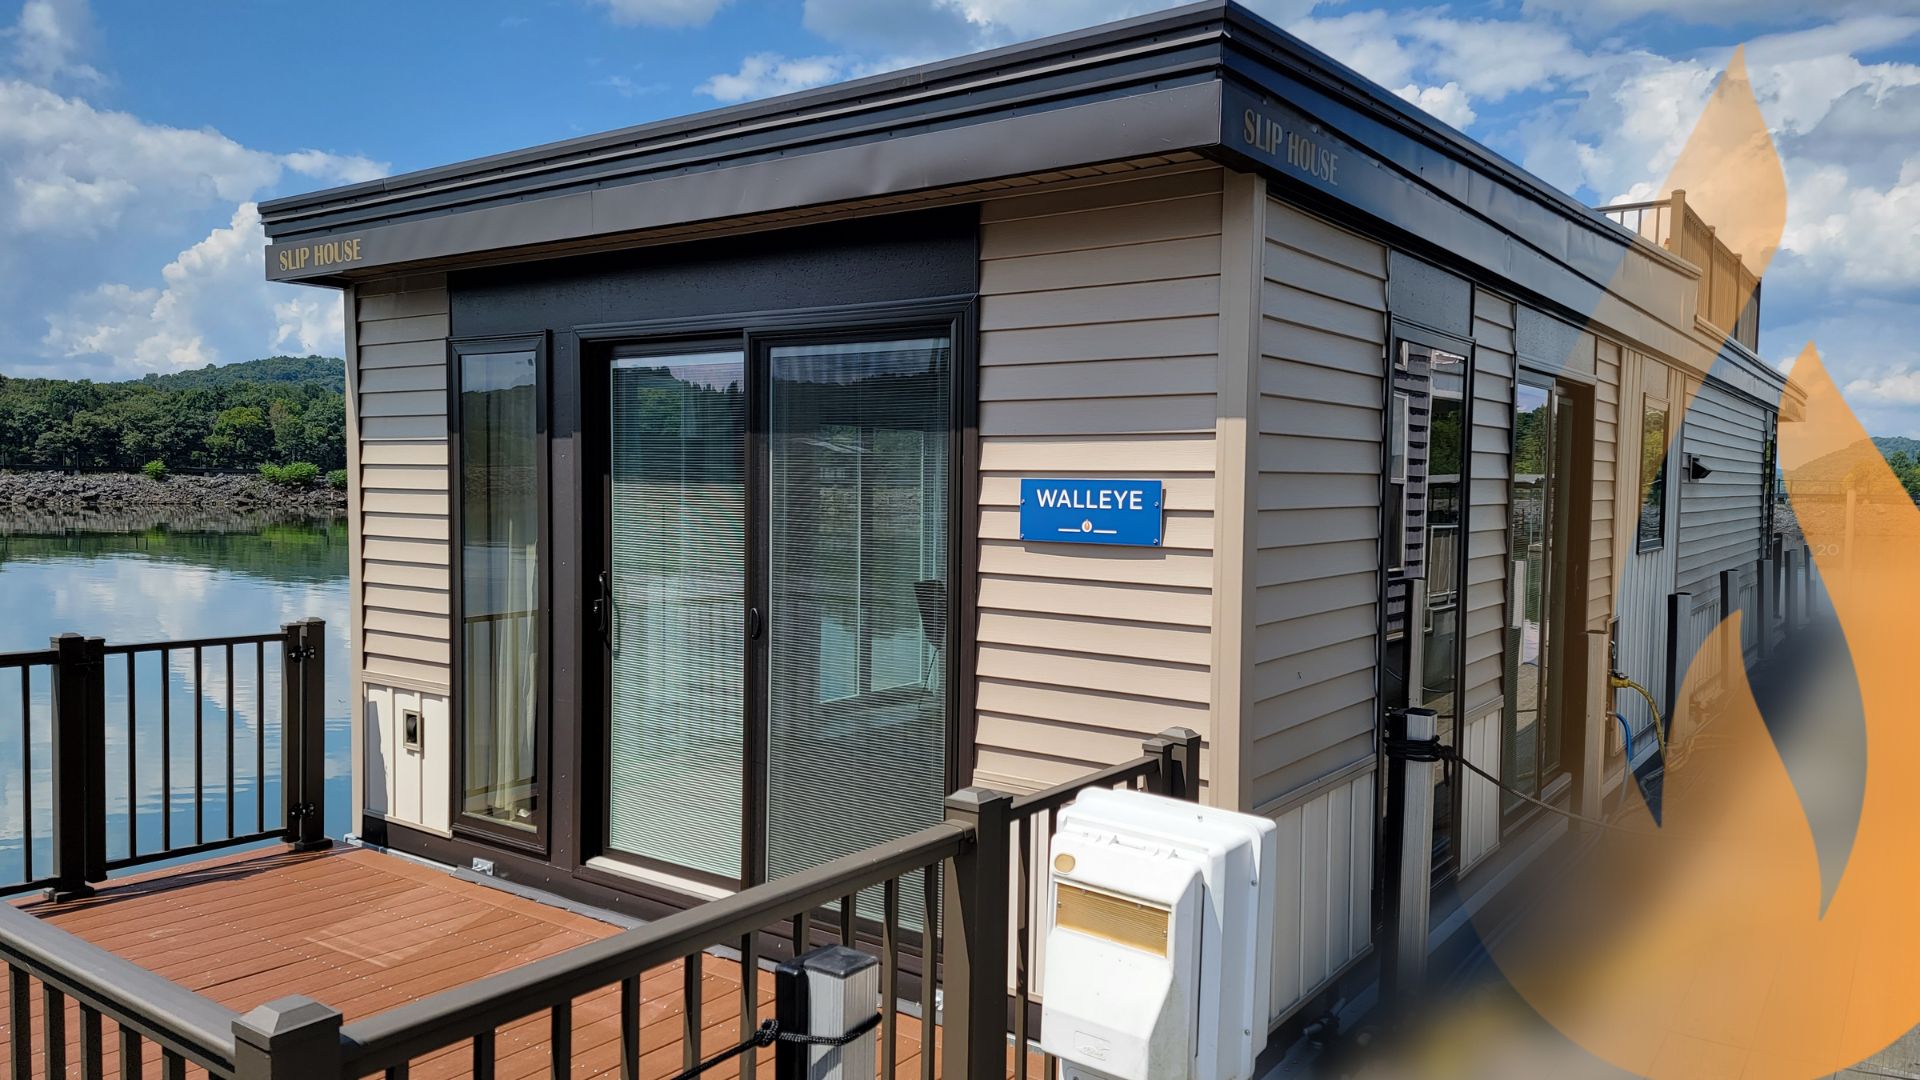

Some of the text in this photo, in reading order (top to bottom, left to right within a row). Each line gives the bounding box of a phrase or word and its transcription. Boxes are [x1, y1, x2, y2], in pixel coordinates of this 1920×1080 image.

[1244, 109, 1338, 186] SLIP HOUSE
[280, 239, 362, 271] SLIP HOUSE
[1036, 489, 1144, 510] WALLEYE
